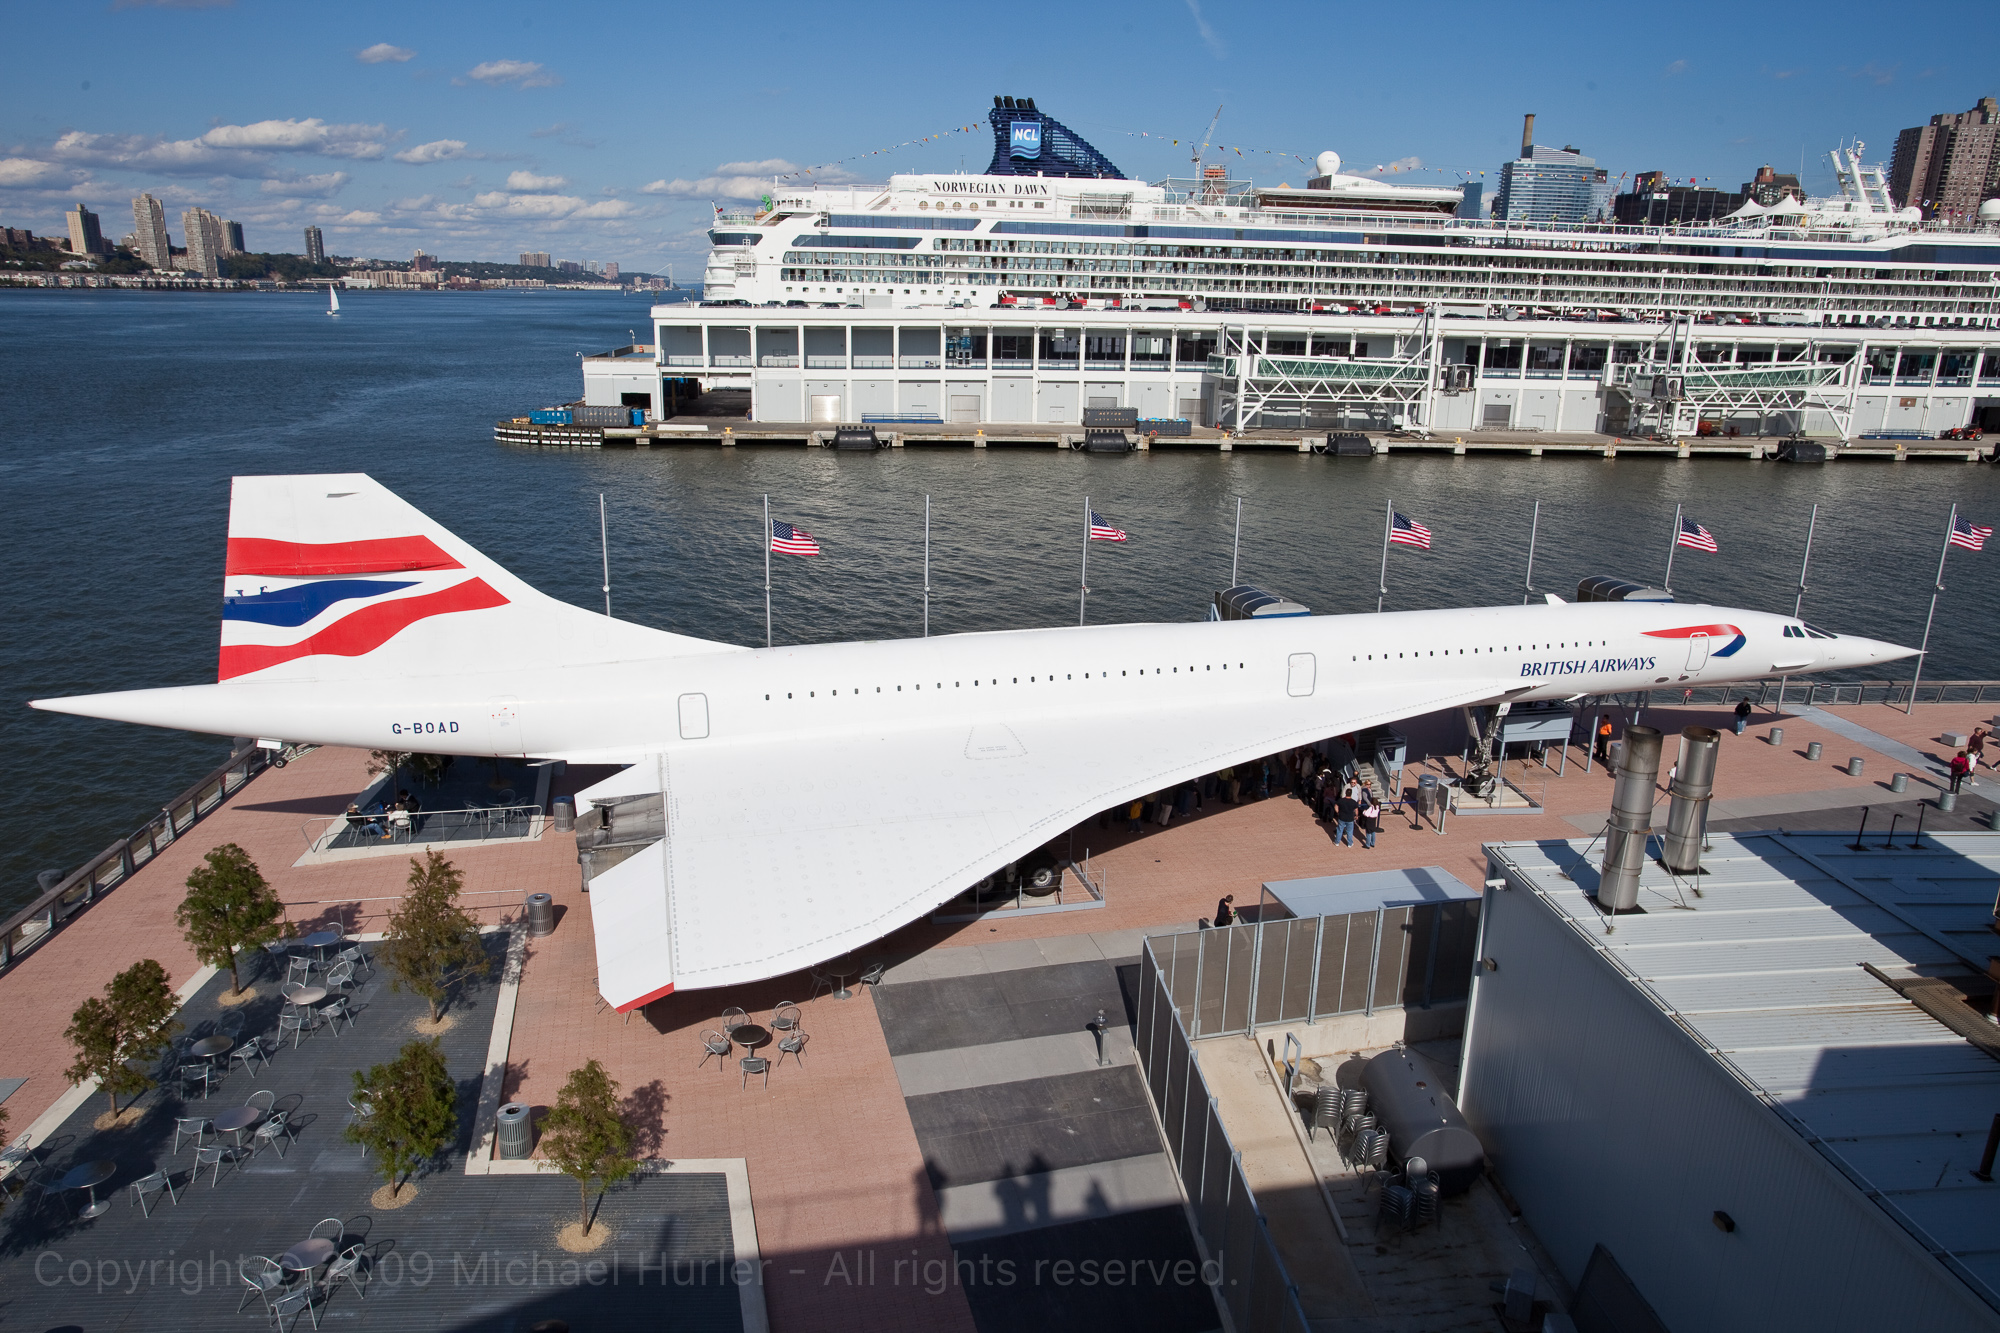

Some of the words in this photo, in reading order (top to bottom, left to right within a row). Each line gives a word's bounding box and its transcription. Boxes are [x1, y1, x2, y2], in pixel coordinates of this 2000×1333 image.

[1014, 128, 1039, 141] NCL
[933, 181, 1006, 194] NORWEGIAN
[1014, 183, 1048, 195] DAWN
[1520, 660, 1587, 677] BRITISH
[1587, 656, 1657, 674] AIRWAYS
[392, 721, 460, 735] G-BOAD
